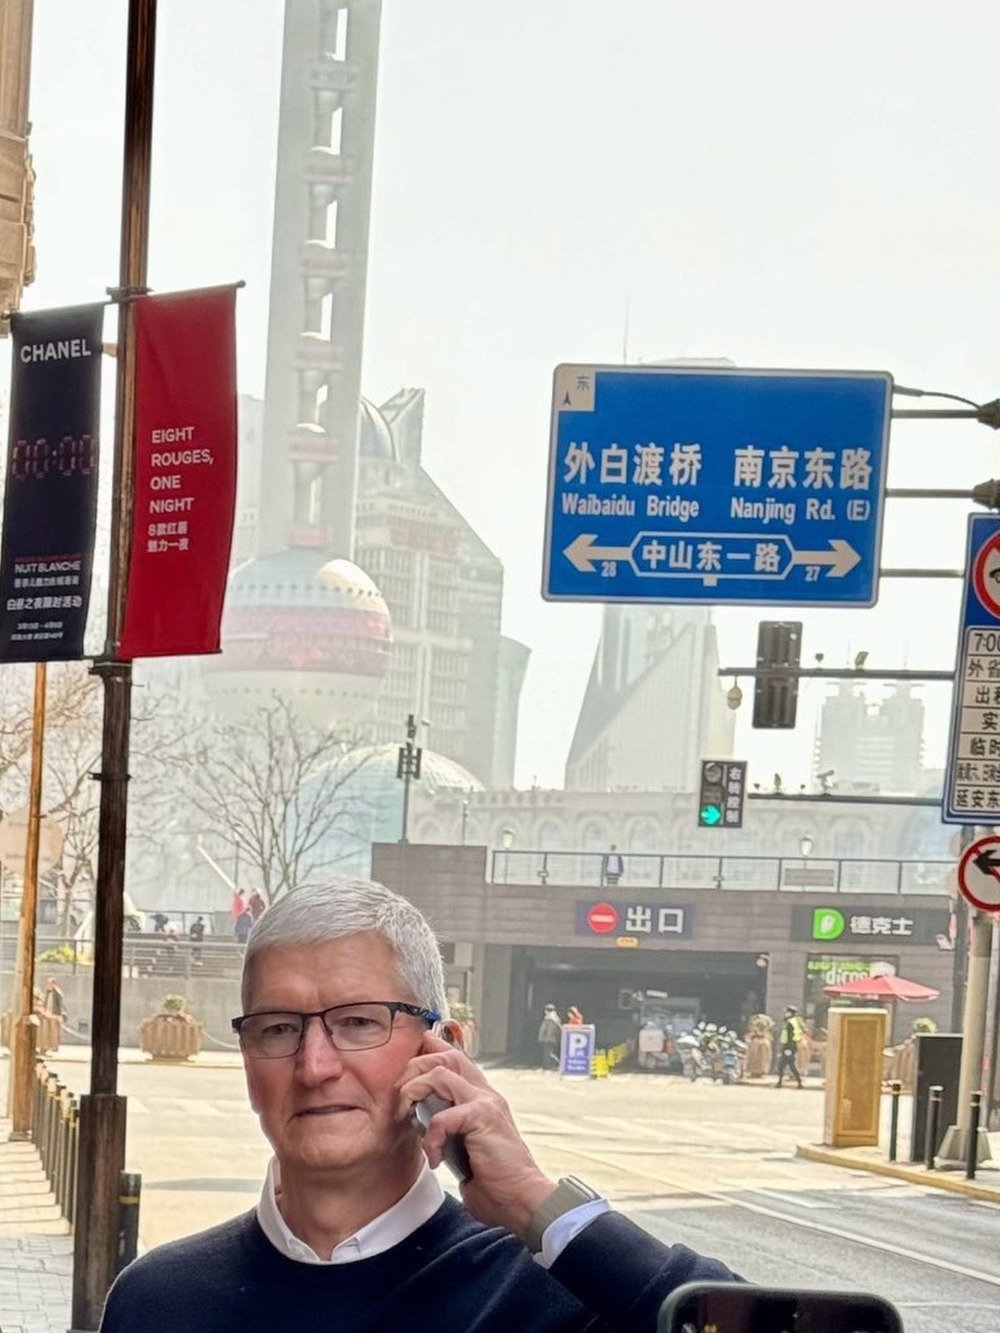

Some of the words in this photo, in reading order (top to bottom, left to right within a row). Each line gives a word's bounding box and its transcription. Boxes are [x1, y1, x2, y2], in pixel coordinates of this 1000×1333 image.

[20, 338, 92, 363] CHANEL
[151, 426, 195, 444] EIGHT
[151, 448, 214, 467] ROUGES,
[563, 441, 703, 487] 外白渡桥
[733, 444, 873, 491] 南京东路
[150, 475, 182, 490] ONE
[149, 497, 195, 514] NIGHT
[561, 492, 637, 517] Waibaidu
[646, 494, 700, 523] Bridge
[730, 496, 797, 525] Nanjing
[805, 497, 837, 521] Rd.
[846, 499, 871, 521] (E)
[641, 539, 782, 574] 中山东一路
[14, 562, 37, 574] NUIT
[37, 560, 82, 573] BLANCHE
[601, 561, 617, 578] 28
[804, 566, 821, 583] 27
[625, 905, 684, 933] 出口
[850, 915, 914, 936] 德克士
[568, 1033, 588, 1058] P
